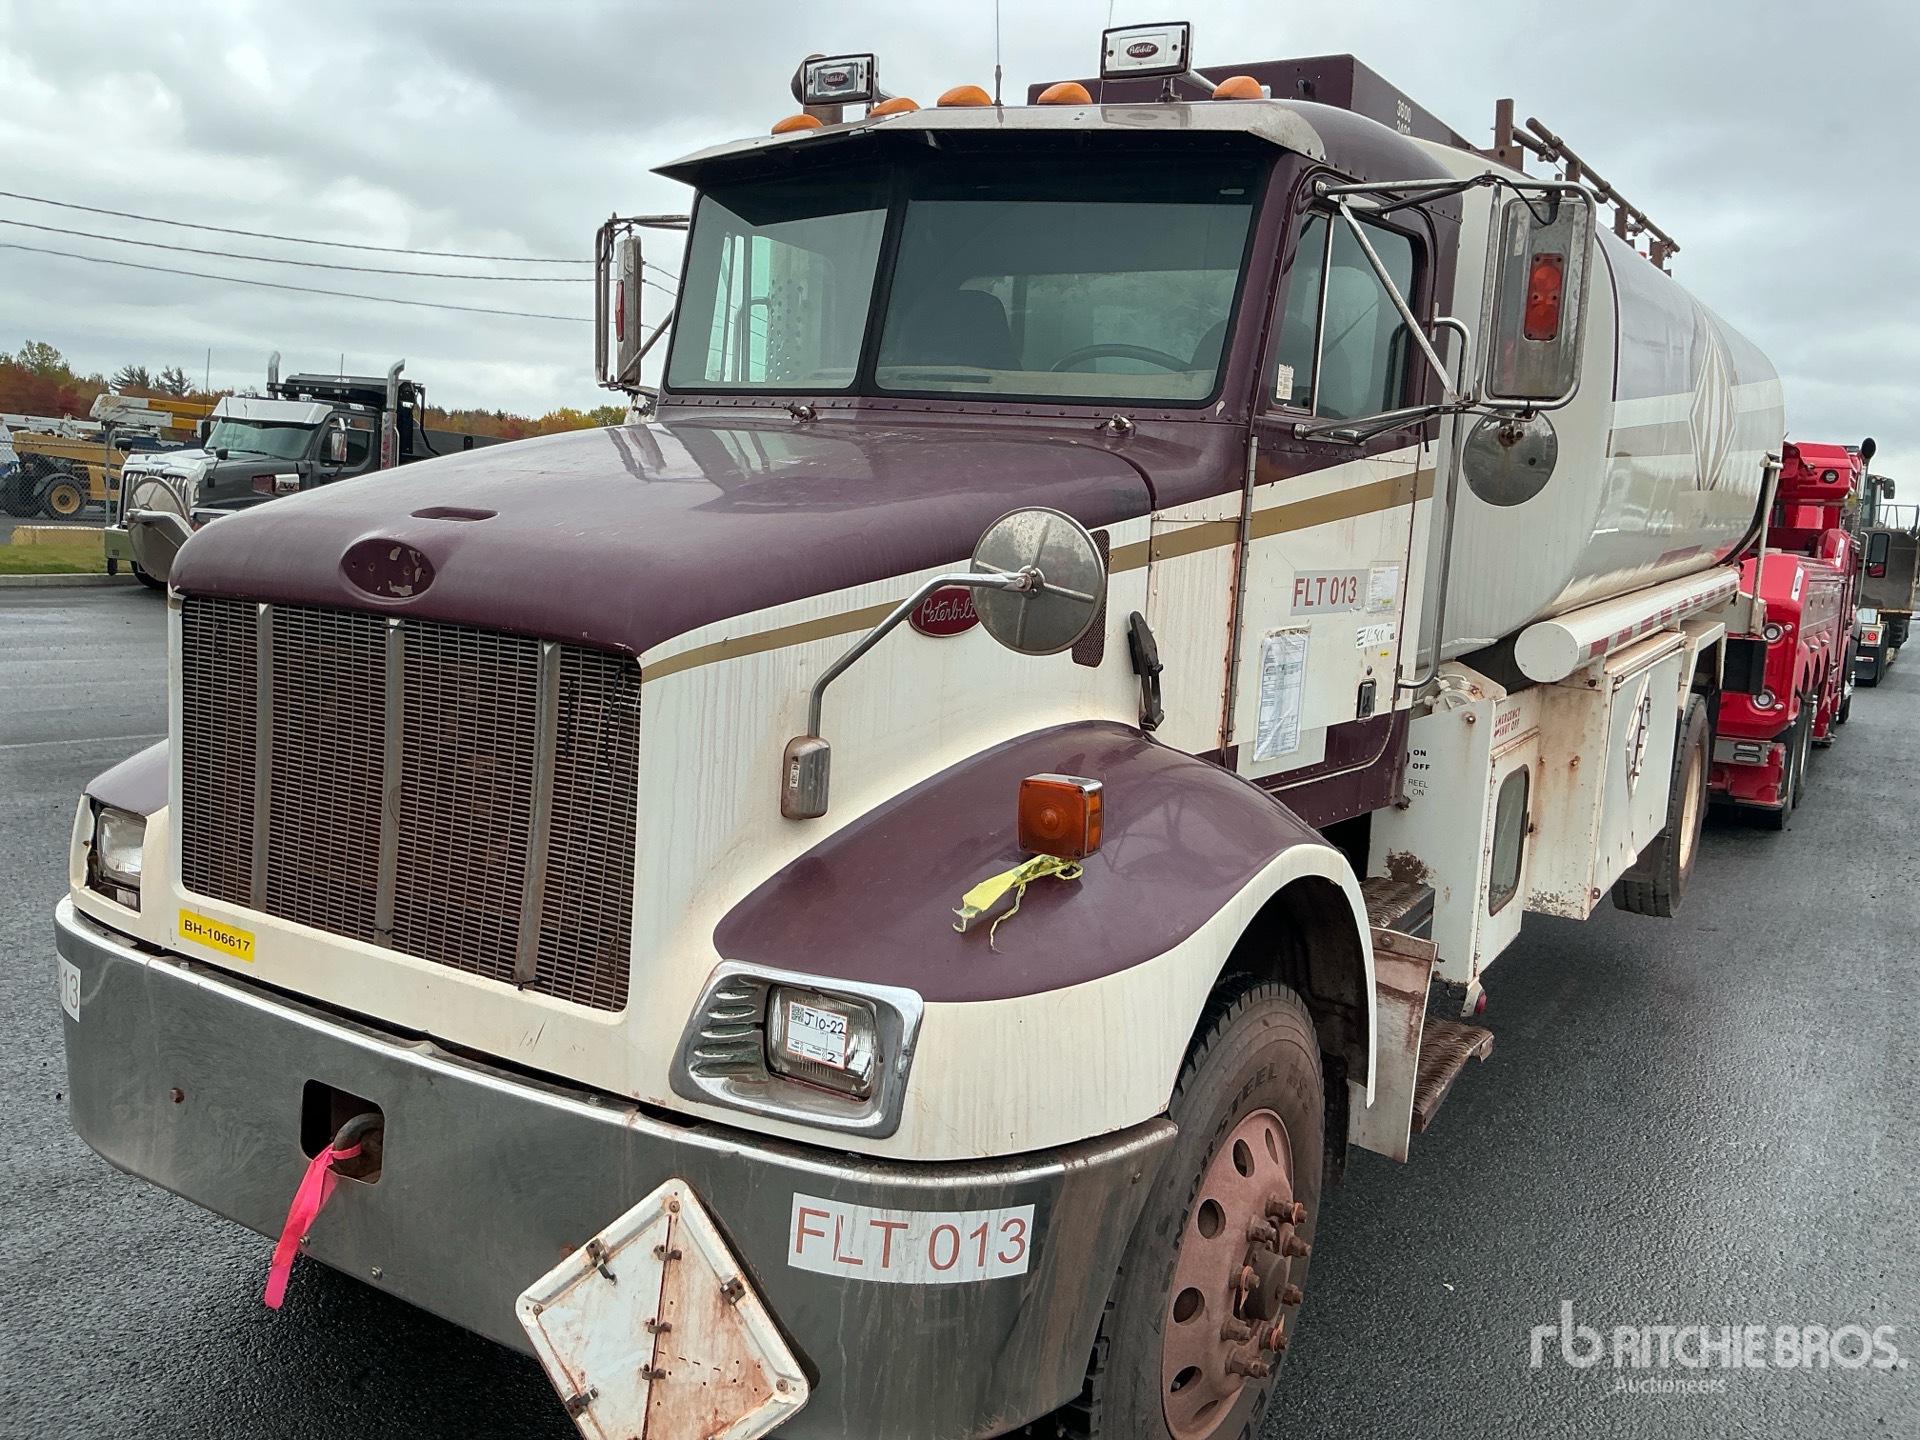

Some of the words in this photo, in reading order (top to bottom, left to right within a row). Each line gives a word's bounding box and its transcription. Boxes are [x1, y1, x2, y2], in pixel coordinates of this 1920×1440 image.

[1293, 577, 1327, 607] FLT
[1329, 576, 1357, 605] 013
[921, 597, 975, 626] Peterbilt
[1412, 762, 1431, 770] OFF
[1413, 749, 1427, 757] ON
[1408, 778, 1428, 788] REEL
[1412, 788, 1425, 796] ON
[184, 919, 250, 952] BH-106617
[58, 961, 78, 1010] 13
[795, 1206, 909, 1269] FLT
[928, 1217, 1027, 1271] 013
